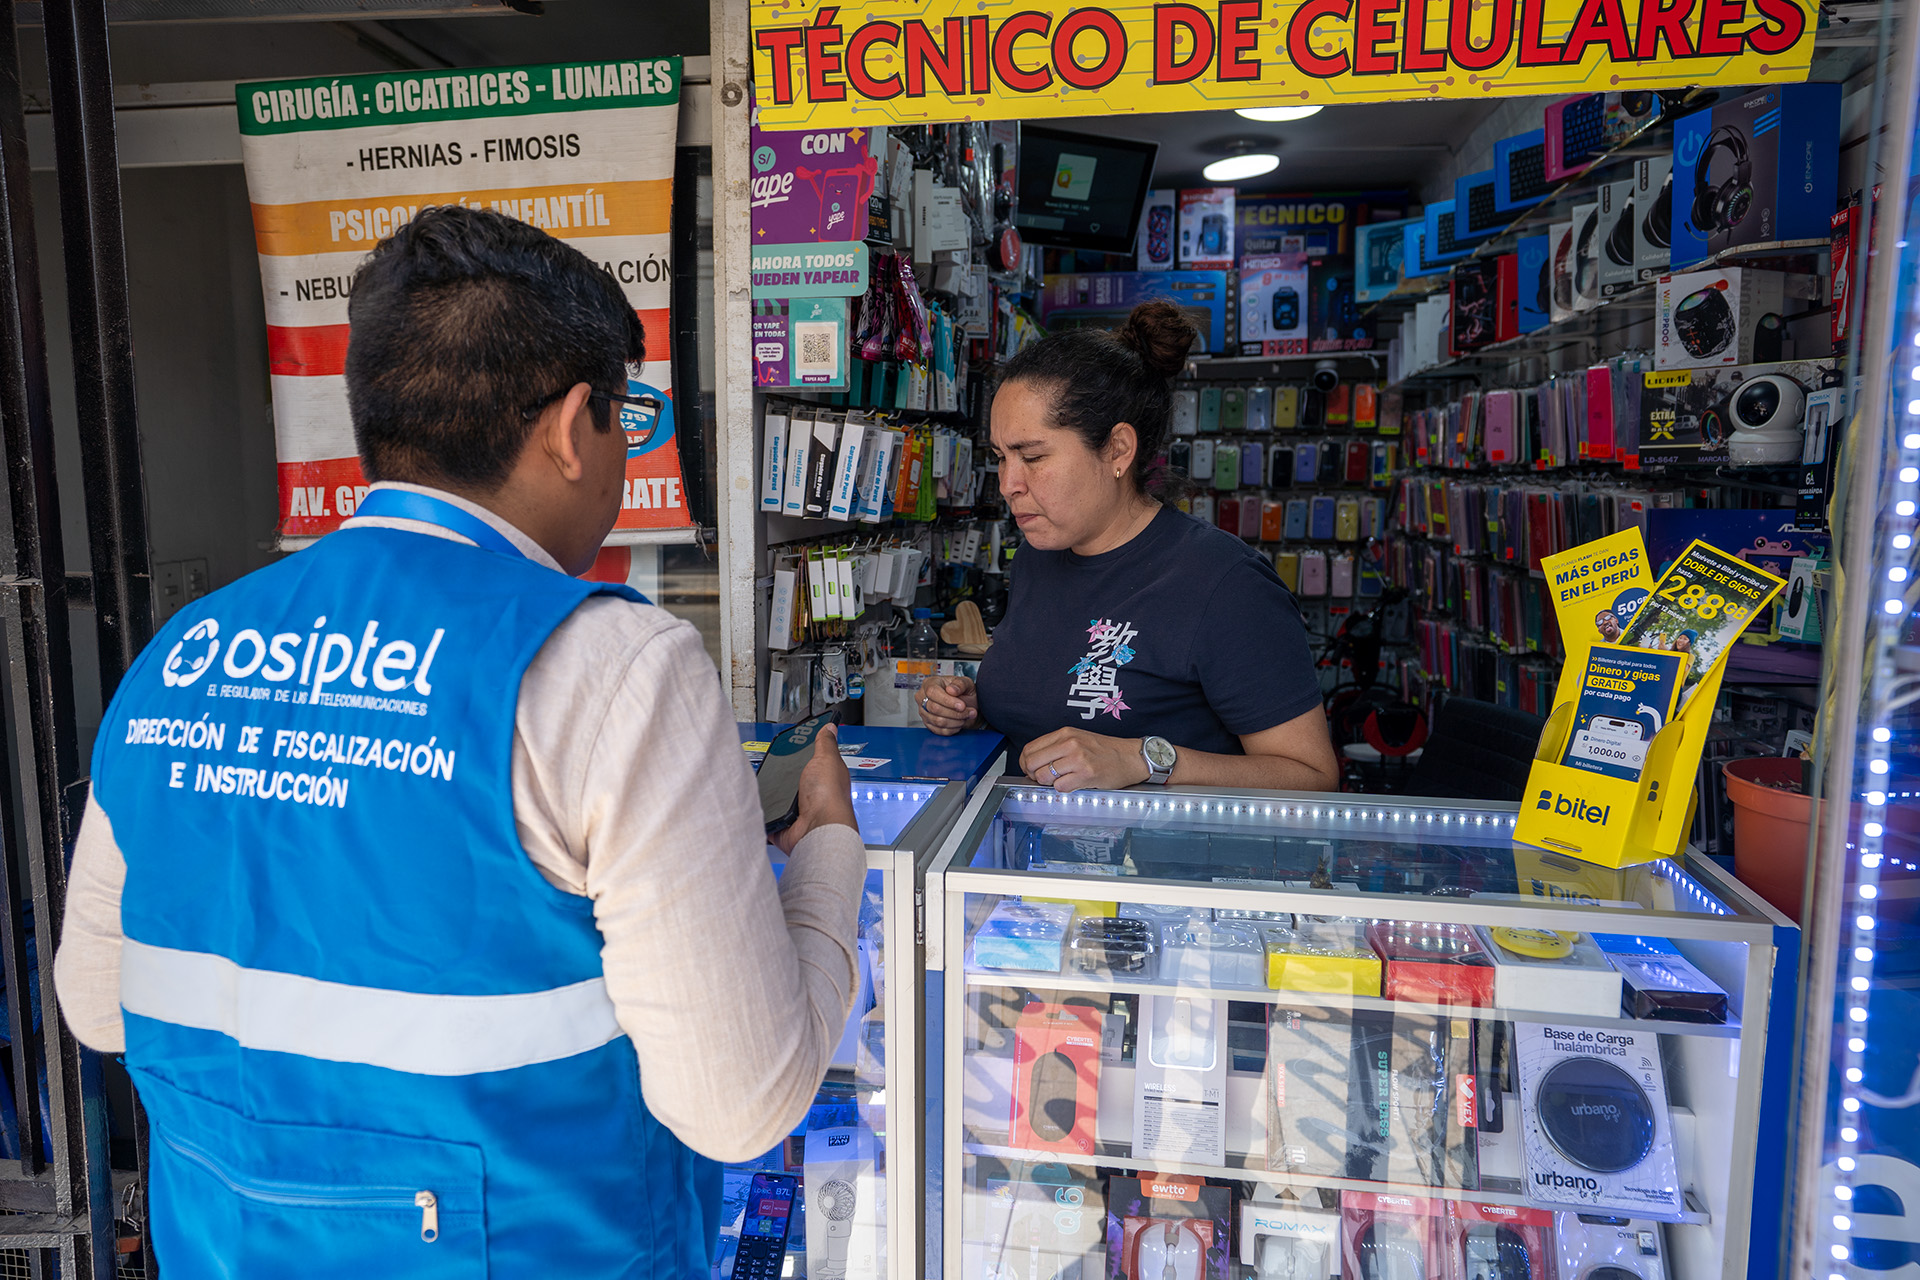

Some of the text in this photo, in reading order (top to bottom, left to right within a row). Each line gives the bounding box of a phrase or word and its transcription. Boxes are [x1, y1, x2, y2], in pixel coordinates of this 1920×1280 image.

[755, 0, 1806, 105] TÉCNICO DE CELULARES
[251, 60, 673, 125] CIRUGÍA CICATRICES LUNARES
[359, 133, 581, 172] HERNIAS FIMOSIS
[801, 133, 846, 155] CON
[1804, 140, 1813, 180] ENKORE
[752, 254, 854, 270] AHORA TODOS
[804, 270, 860, 284] YAPEAR
[1661, 289, 1671, 347] WATERPROOF
[765, 330, 786, 338] TODAS
[1650, 411, 1676, 420] EXTRA
[841, 482, 850, 500] Pared
[872, 485, 880, 502] Pared
[290, 487, 331, 516] AV.
[1555, 548, 1639, 585] MÁS GIGAS
[1676, 567, 1694, 579] hasta
[1690, 550, 1716, 568] Muévete
[1721, 563, 1736, 576] Bitel
[1739, 572, 1761, 588] recibe
[1560, 586, 1580, 602] EN
[1582, 581, 1599, 595] EL
[1602, 563, 1640, 588] PERÚ
[1682, 558, 1761, 601] DOBLE DE GIGAS
[1650, 600, 1662, 609] por
[1668, 610, 1687, 622] meses
[223, 615, 445, 706] osiptel
[1598, 656, 1616, 665] Billetera
[1616, 658, 1631, 667] digital
[1643, 662, 1657, 670] todos
[1589, 663, 1661, 683] Dinero y gigas
[1591, 677, 1628, 691] GRATIS
[274, 689, 290, 703] DE
[1584, 688, 1632, 703] por cada pago
[125, 712, 455, 781] DIRECCIÓN DE FISCALIZACIÓN
[1588, 746, 1627, 761] 1,000.00
[169, 762, 349, 809] E INSTRUCCIÓN
[1555, 793, 1611, 826] bitel
[1066, 1035, 1094, 1044] CYBERTEL
[1543, 1028, 1635, 1046] Base de Carga
[1553, 1039, 1627, 1056] Inalámbrica
[1144, 1082, 1176, 1093] WIRELESS
[1377, 1051, 1390, 1137] SUPER BASS
[1391, 1069, 1400, 1117] FLOW SPORT
[1463, 1101, 1473, 1124] VEX
[1570, 1104, 1617, 1117] urbano
[1151, 1184, 1185, 1195] ewtto
[1535, 1172, 1597, 1191] urbano
[1377, 1195, 1412, 1206] CYBERTEL
[1482, 1205, 1518, 1217] CYBERTEL
[1255, 1218, 1326, 1234] ROMAX
